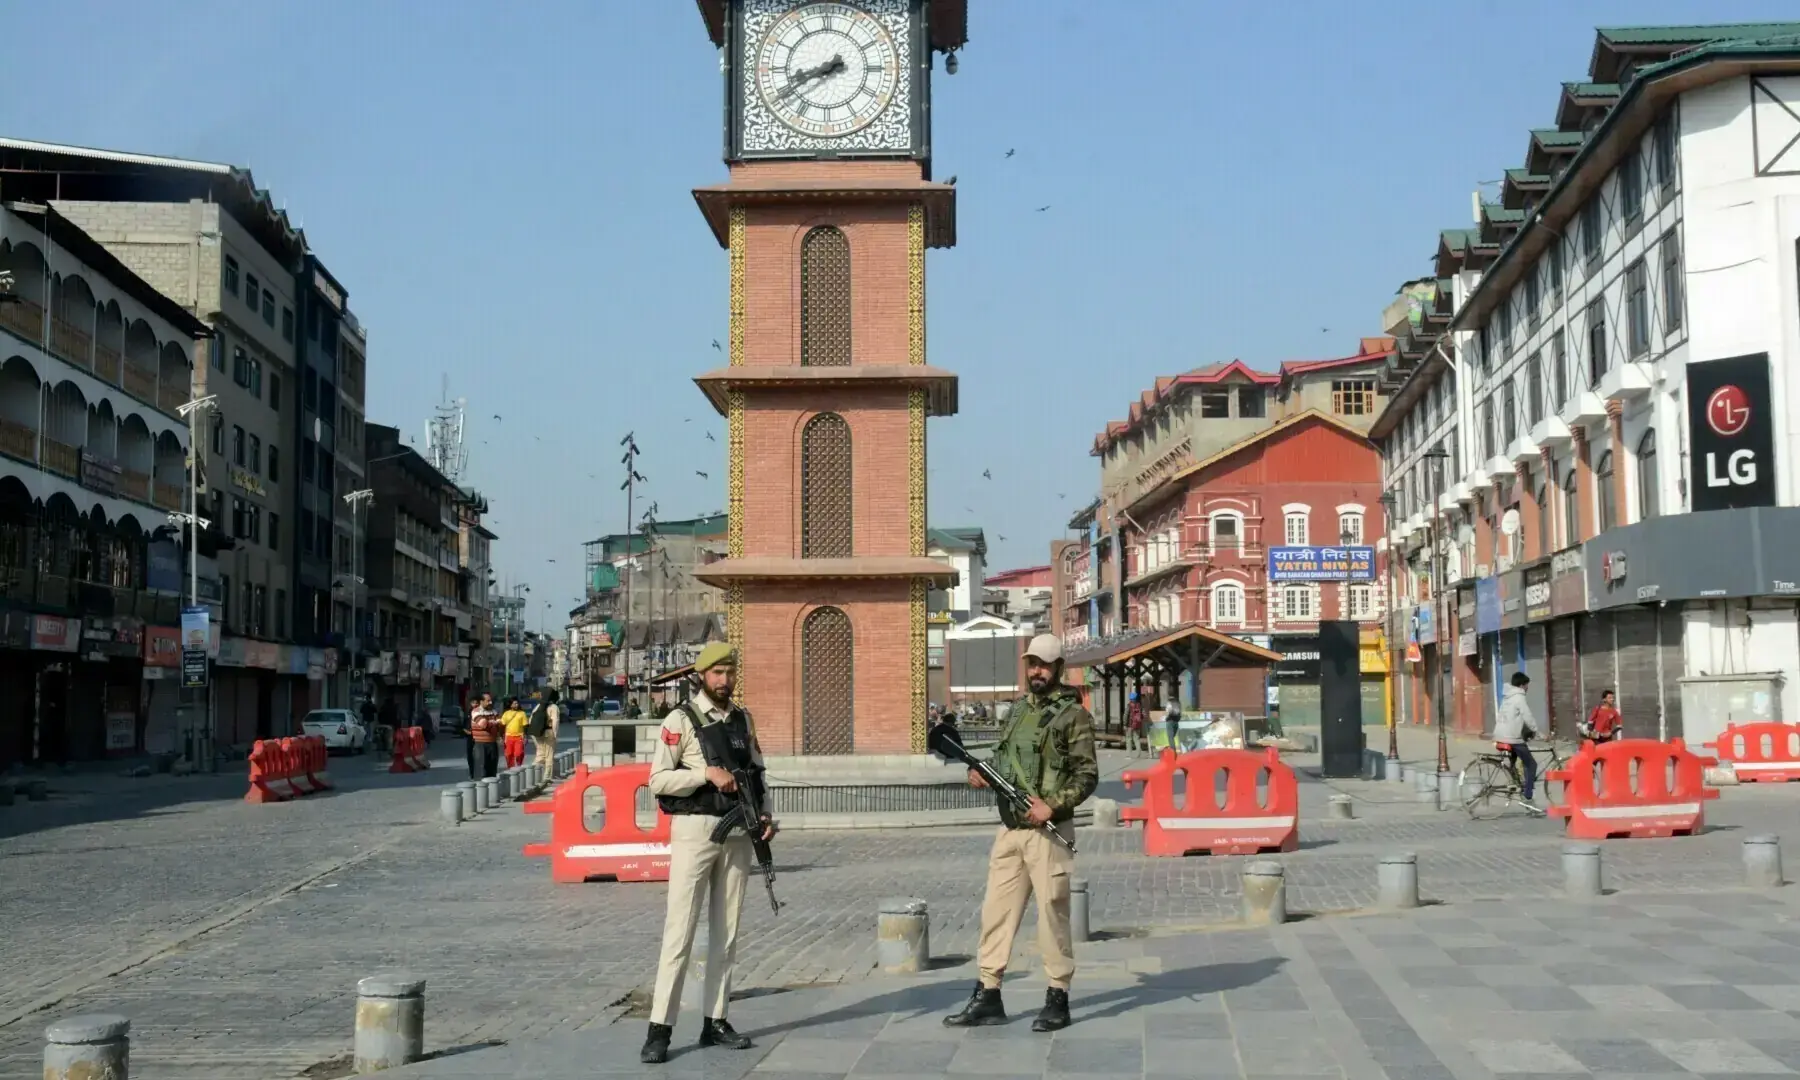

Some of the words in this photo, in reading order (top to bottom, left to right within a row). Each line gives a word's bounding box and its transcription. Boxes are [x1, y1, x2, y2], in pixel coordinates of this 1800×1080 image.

[1706, 448, 1757, 487] LG
[1272, 548, 1316, 560] यात्री
[1275, 561, 1318, 570] YATRI
[1322, 561, 1369, 570] NIWAS
